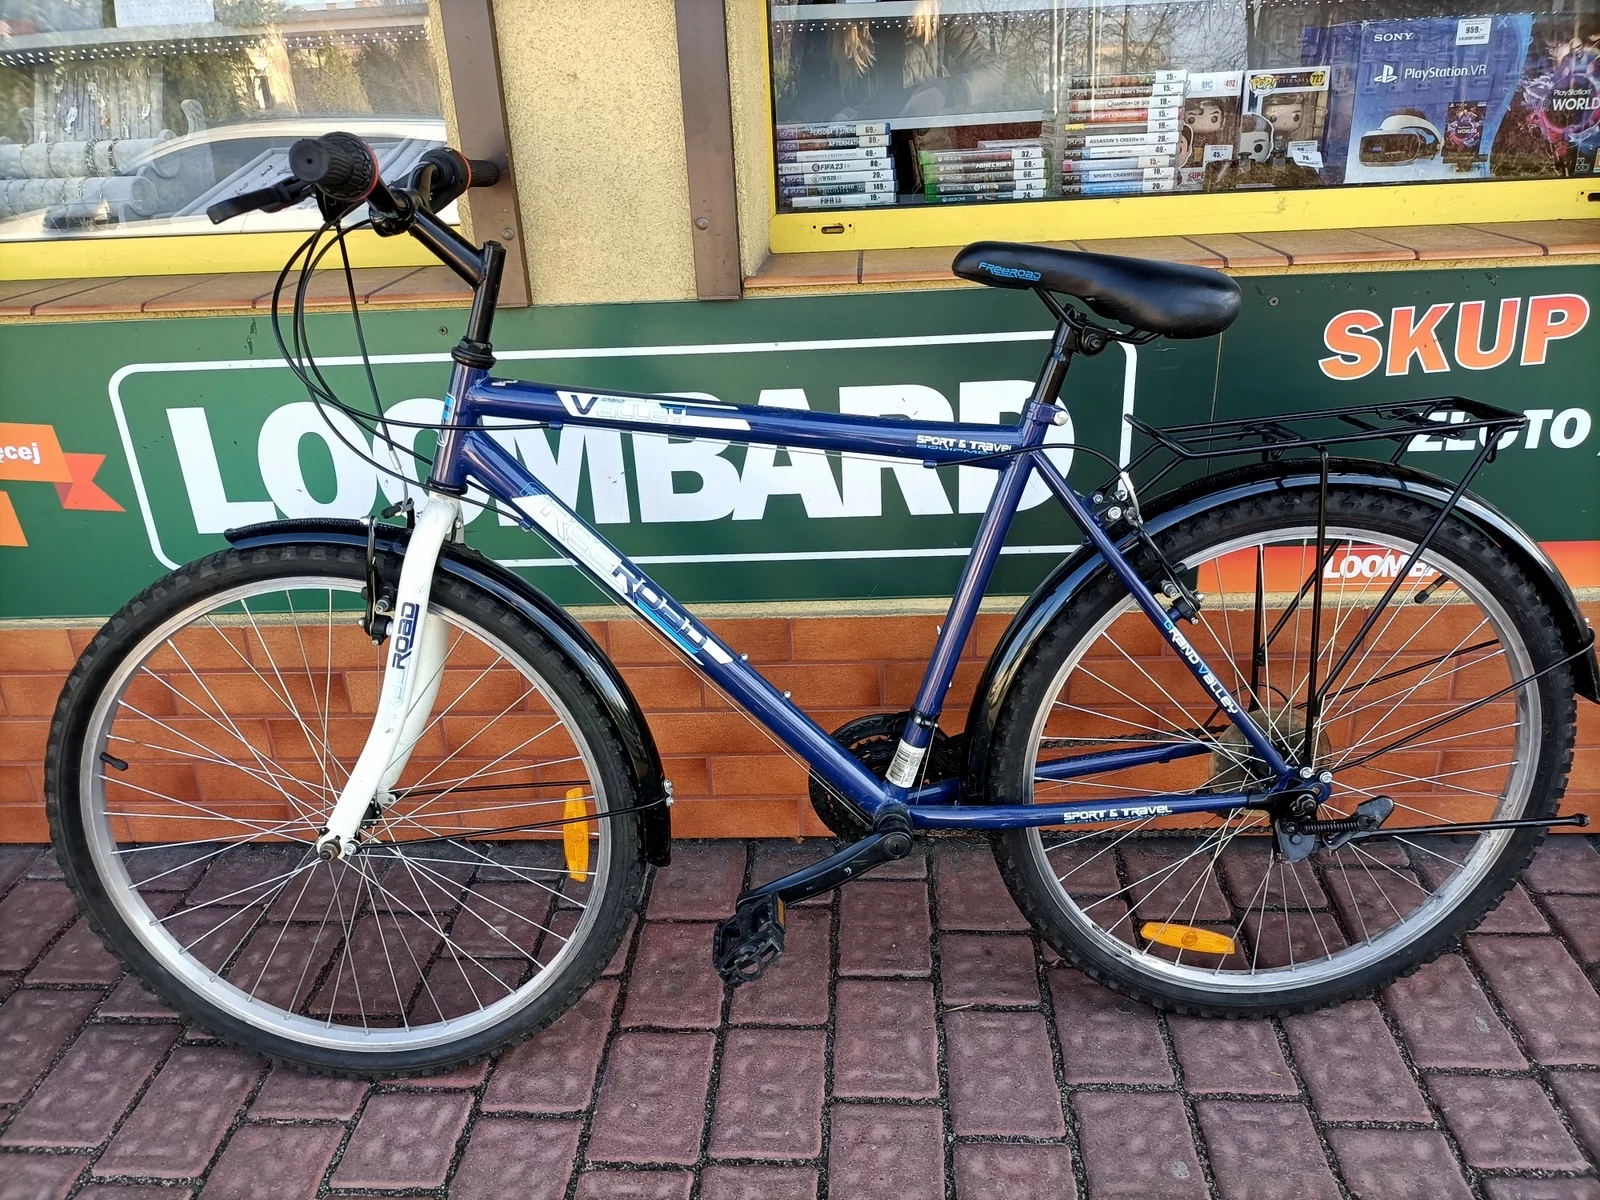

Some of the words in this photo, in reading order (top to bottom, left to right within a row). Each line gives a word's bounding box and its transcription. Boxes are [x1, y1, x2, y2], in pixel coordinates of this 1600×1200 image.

[1373, 32, 1413, 42] SONY
[1249, 76, 1277, 91] POP!
[1311, 74, 1324, 83] 727
[1318, 293, 1590, 381] SKUP
[916, 434, 957, 449] SPORT
[165, 379, 1075, 535] LOOMBARD
[1063, 810, 1107, 821] SPORT
